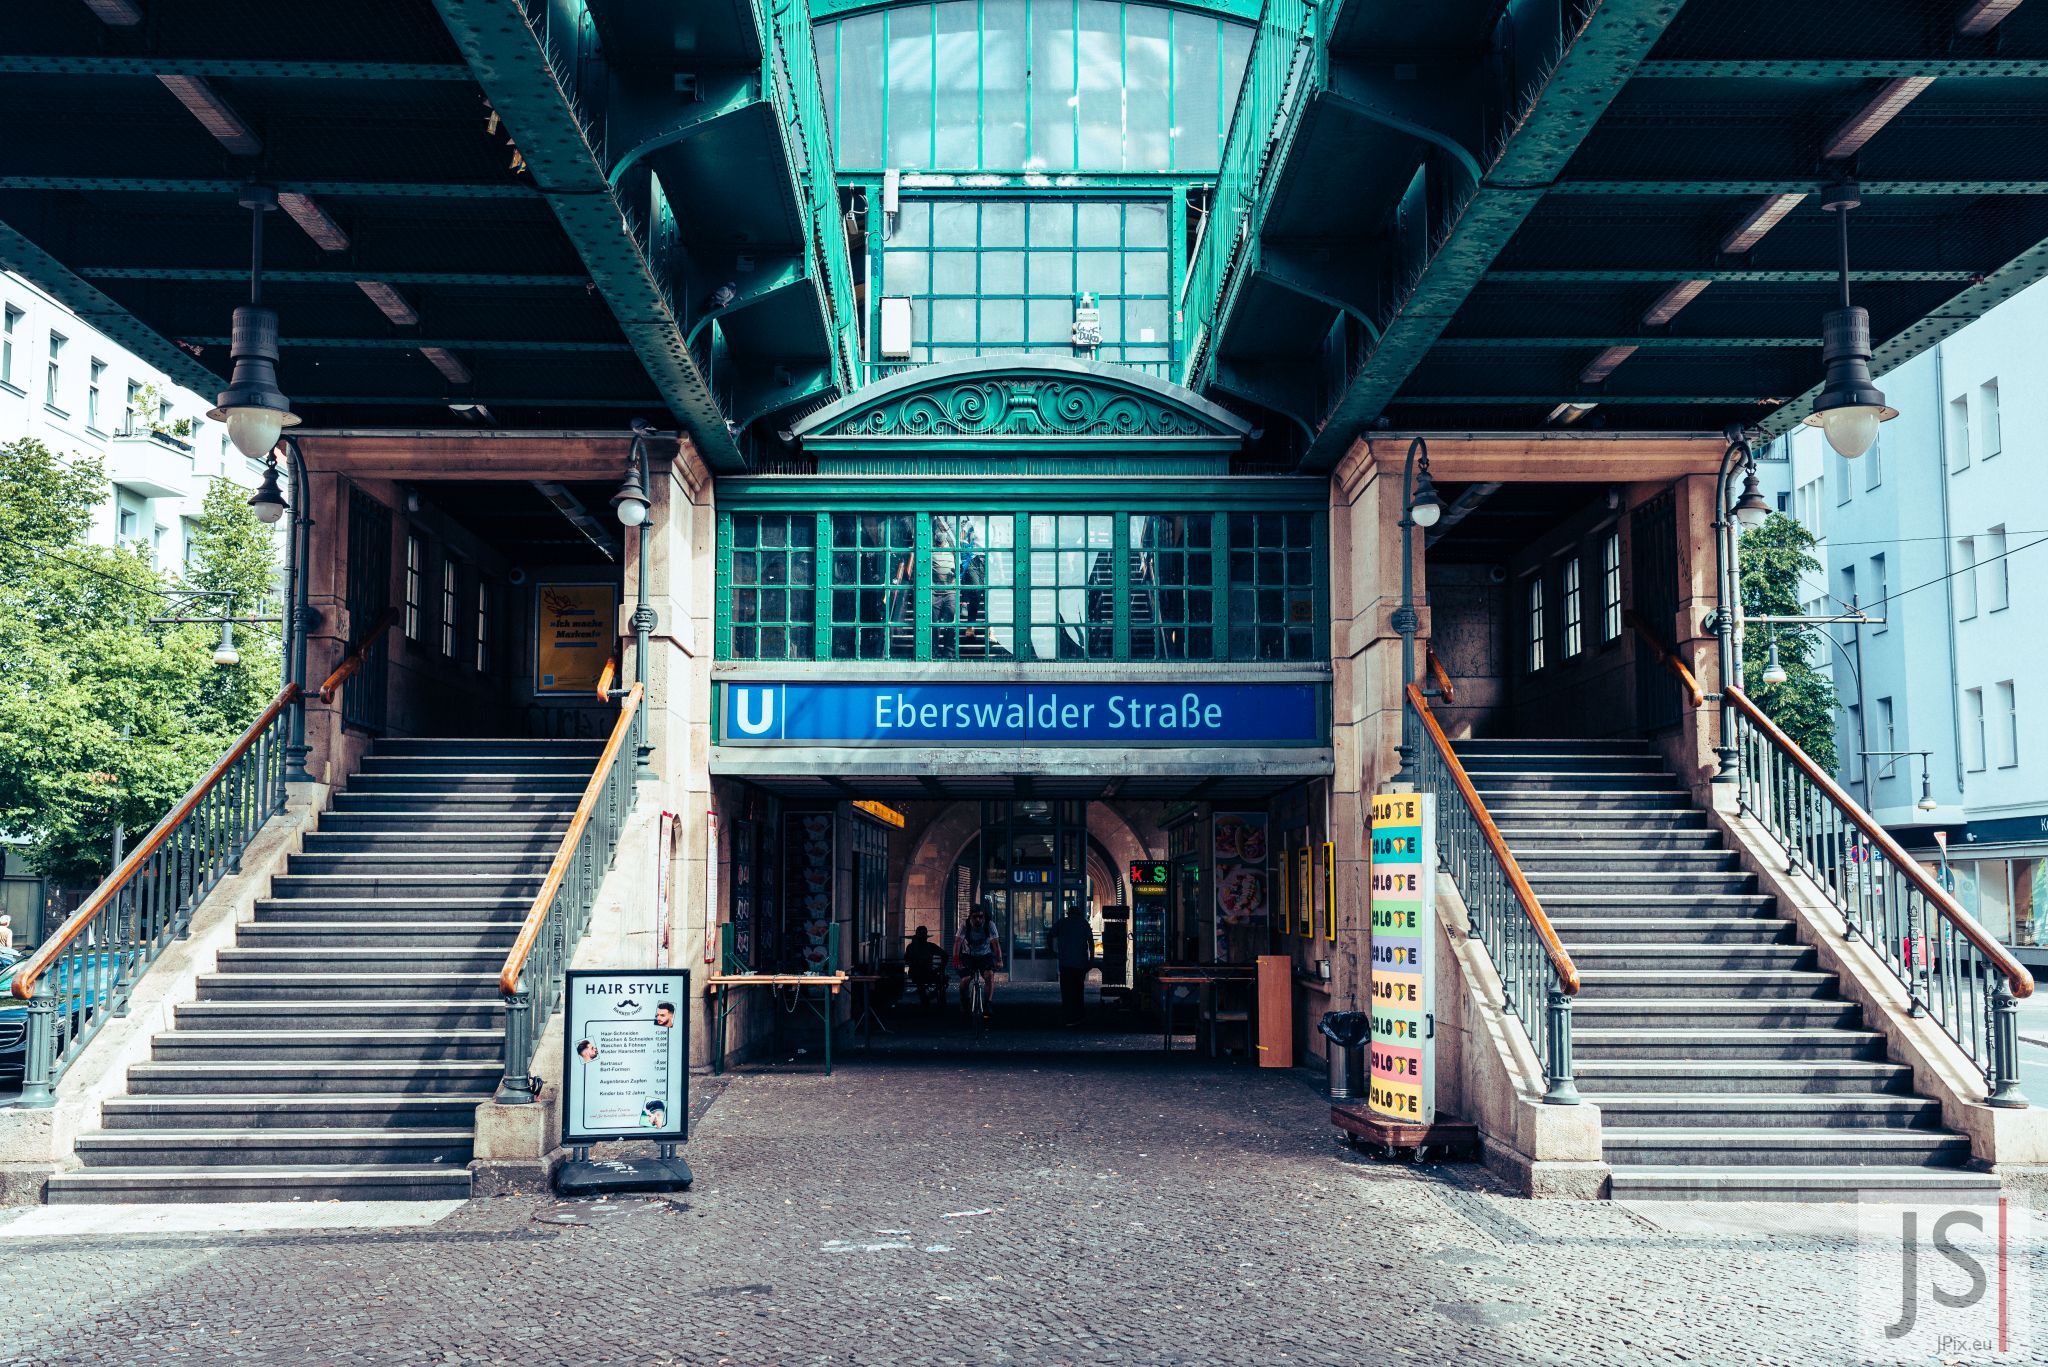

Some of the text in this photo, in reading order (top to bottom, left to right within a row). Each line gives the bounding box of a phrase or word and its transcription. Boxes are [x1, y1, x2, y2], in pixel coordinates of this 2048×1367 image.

[737, 688, 1222, 734] U Eberswalder Straße
[1014, 871, 1023, 882] U
[585, 983, 669, 994] HAIR STYLE
